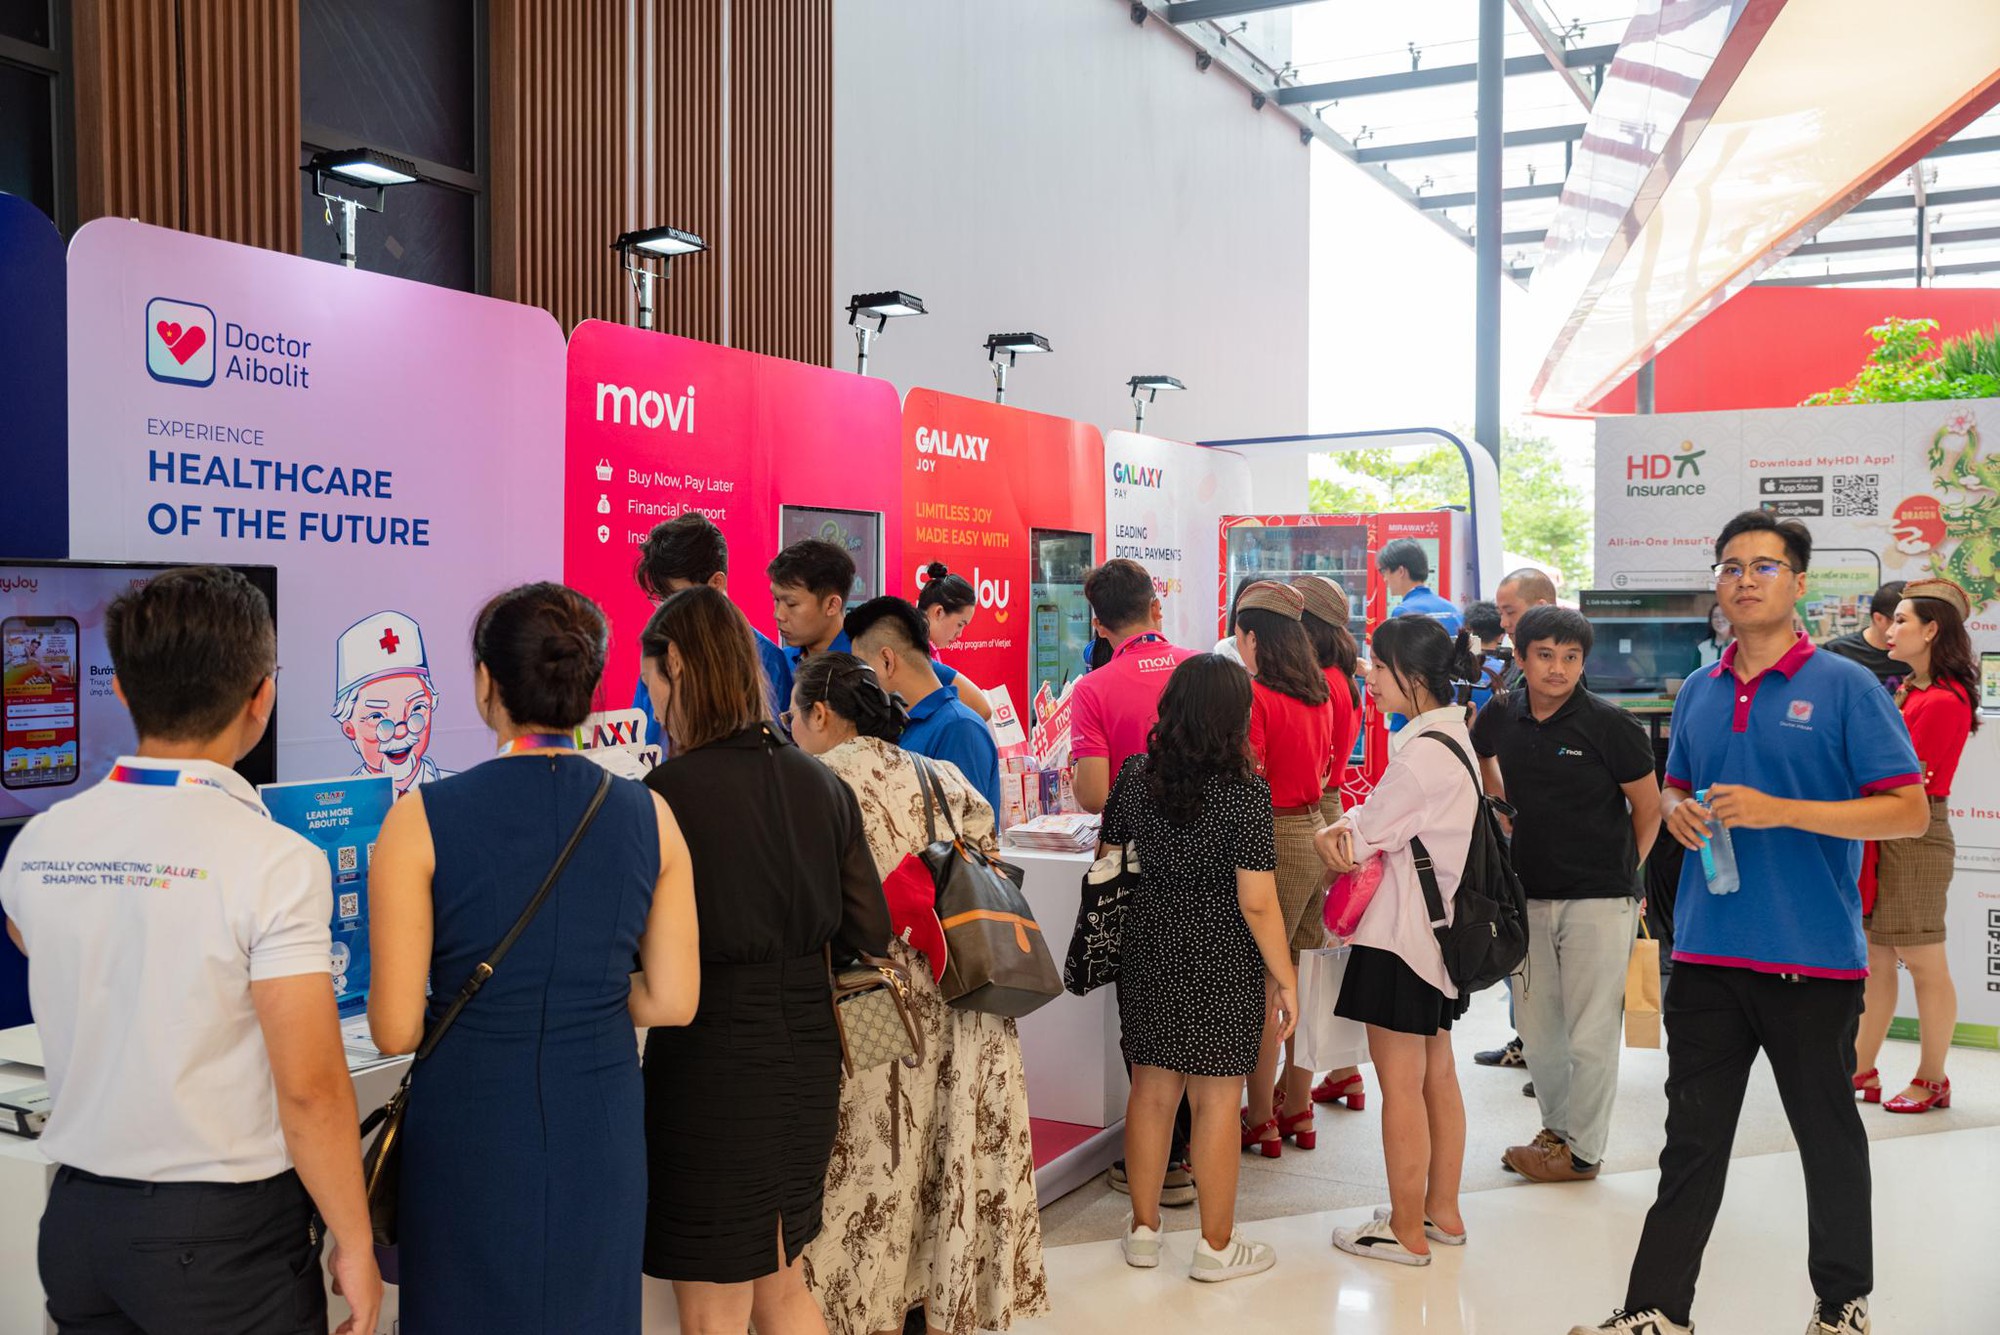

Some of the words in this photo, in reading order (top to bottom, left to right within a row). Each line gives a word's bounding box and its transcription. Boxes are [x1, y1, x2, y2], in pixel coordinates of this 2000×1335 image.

[226, 323, 311, 358] Doctor
[226, 355, 309, 389] Aibolit
[596, 382, 695, 434] movi
[147, 418, 265, 446] EXPERIENCE
[915, 426, 990, 462] GALAXY
[916, 458, 936, 472] JOY
[1749, 459, 1812, 469] Download
[1817, 456, 1859, 467] MyHDI
[1864, 454, 1895, 465] App!
[149, 450, 393, 499] HEALTHCARE
[628, 468, 652, 488] Buy
[655, 472, 683, 490] Now,
[685, 474, 705, 493] Pay
[707, 477, 734, 493] Later
[1113, 462, 1163, 489] GALAXY
[1114, 488, 1128, 499] PAY
[1626, 484, 1706, 497] Insurance
[628, 499, 680, 517] Financial
[916, 501, 970, 522] LIMITLESS
[972, 507, 993, 524] JOY
[147, 502, 202, 536] OF
[213, 506, 286, 540] THE
[300, 511, 430, 546] FUTURE
[1115, 524, 1148, 540] LEADING
[1388, 524, 1426, 532] MIRAWAY
[916, 526, 949, 545] MADE
[951, 528, 979, 546] EASY
[981, 531, 1010, 548] WITH
[1608, 537, 1669, 547] All-in-One
[1115, 545, 1143, 559] DIGITAL
[1145, 547, 1182, 561] PAYMENTS
[965, 641, 988, 651] program
[1138, 653, 1176, 669] movi
[574, 720, 639, 751] LAXY
[306, 810, 328, 820] LEAN
[330, 807, 354, 818] MORE
[309, 818, 337, 829] ABOUT
[338, 817, 350, 826] US
[21, 860, 75, 872] DIGITALLY
[77, 861, 153, 873] CONNECTING
[155, 864, 209, 880] VALUES
[42, 874, 97, 885] SHAPING
[101, 874, 124, 885] THE
[126, 875, 171, 889] FUTURE
